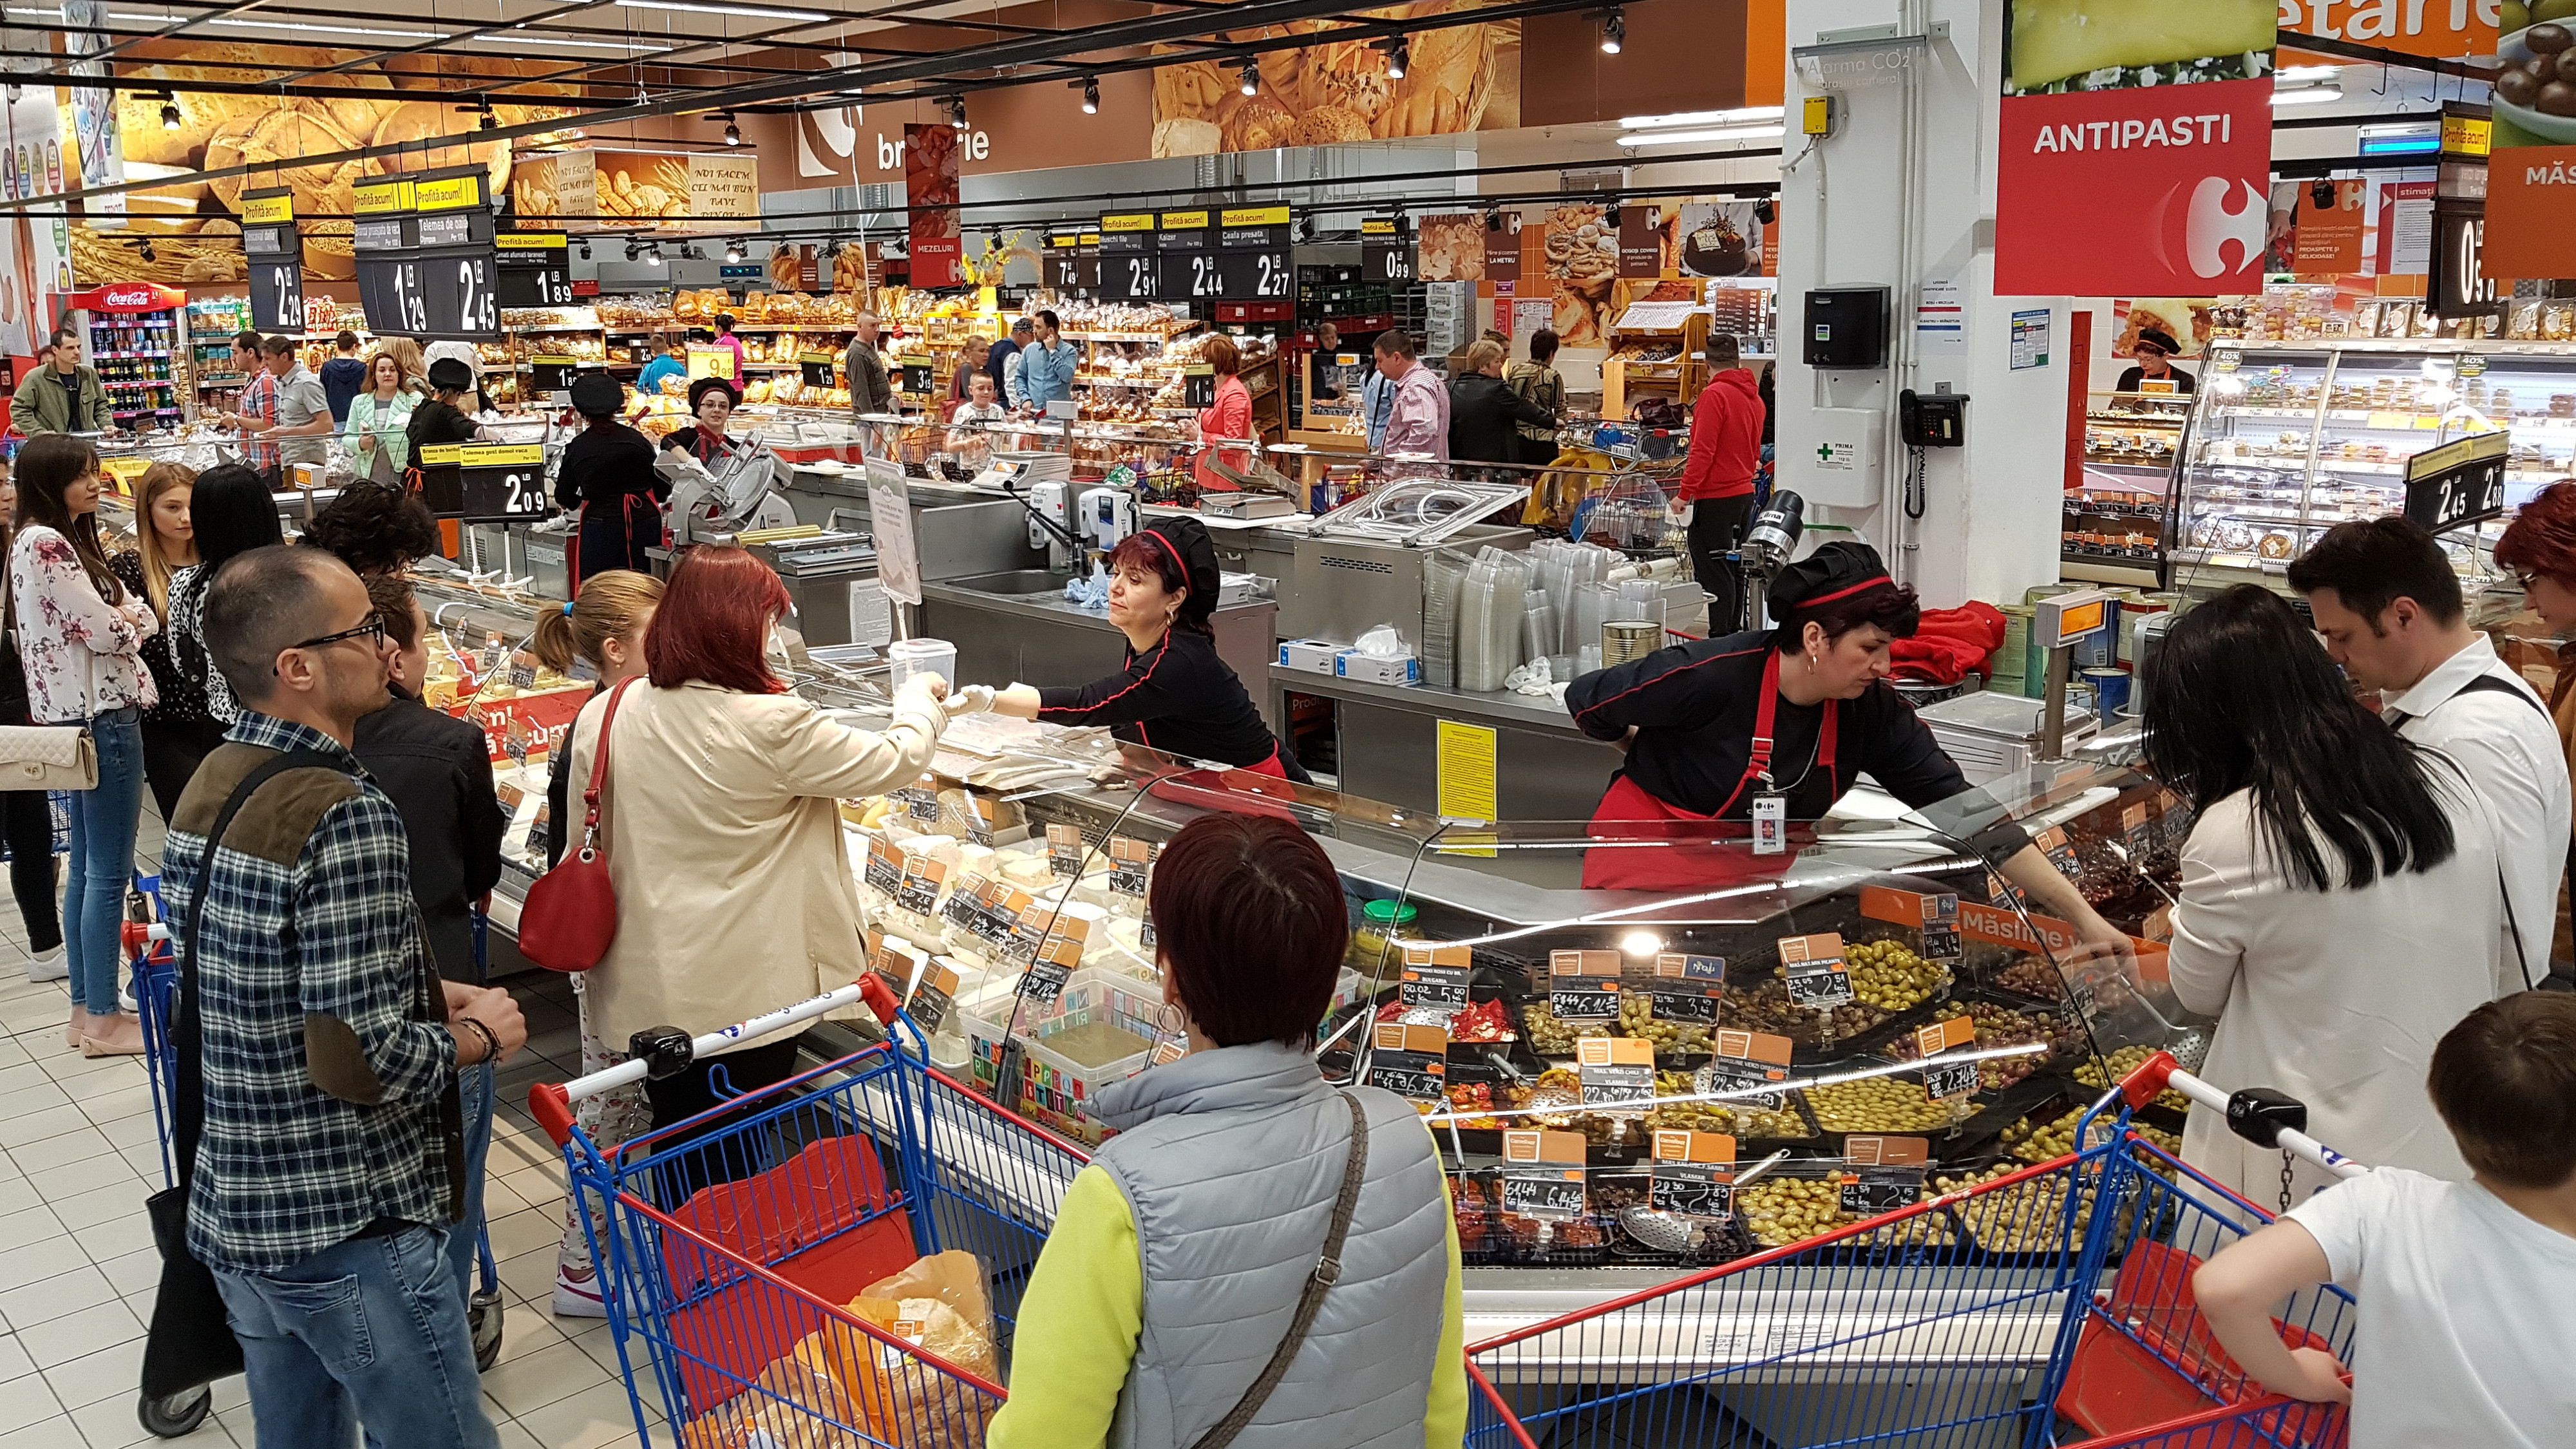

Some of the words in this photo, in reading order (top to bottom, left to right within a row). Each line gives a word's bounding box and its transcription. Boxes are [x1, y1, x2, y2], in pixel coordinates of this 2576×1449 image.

[1808, 59, 1865, 75] Alarma
[2034, 113, 2231, 154] ANTIPASTI
[2445, 128, 2467, 144] Profită
[695, 169, 714, 178] NOI
[716, 169, 750, 180] FACEM
[418, 189, 440, 202] Profită
[692, 184, 708, 192] CEL
[710, 184, 730, 192] MAI
[733, 184, 757, 194] BUN
[354, 193, 374, 206] Profită
[419, 218, 444, 232] Telemea
[1103, 220, 1121, 228] Profită
[1164, 217, 1184, 225] Profită
[1223, 214, 1244, 223] Profită
[918, 244, 954, 253] MEZELURI
[1387, 252, 1396, 278] 0
[1396, 263, 1408, 278] 99
[2461, 220, 2474, 305] 0
[1059, 262, 1066, 285] 7
[1068, 272, 1075, 285] 49
[1129, 258, 1141, 296] 2
[1143, 276, 1156, 296] 91
[1192, 257, 1204, 296] 2
[1207, 274, 1222, 296] 44
[1257, 255, 1271, 296] 2
[1273, 273, 1289, 296] 27
[275, 267, 289, 325] 2
[289, 295, 302, 326] 29
[460, 261, 476, 330] 2
[478, 293, 495, 330] 45
[537, 271, 549, 303] 1
[554, 286, 572, 303] 89
[395, 265, 409, 330] 1
[409, 296, 426, 331] 29
[559, 368, 565, 386] 1
[710, 358, 720, 377] 9
[721, 368, 733, 377] 99
[819, 366, 824, 384] 1
[918, 370, 924, 389] 3
[1195, 380, 1200, 403] 1
[1205, 390, 1213, 403] 94
[505, 474, 522, 513] 2
[524, 491, 544, 512] 09
[2482, 467, 2494, 511] 2
[2492, 486, 2503, 507] 88
[2438, 478, 2452, 524] 2
[2451, 493, 2466, 518] 45
[1680, 1172, 1706, 1181] VLAMAR
